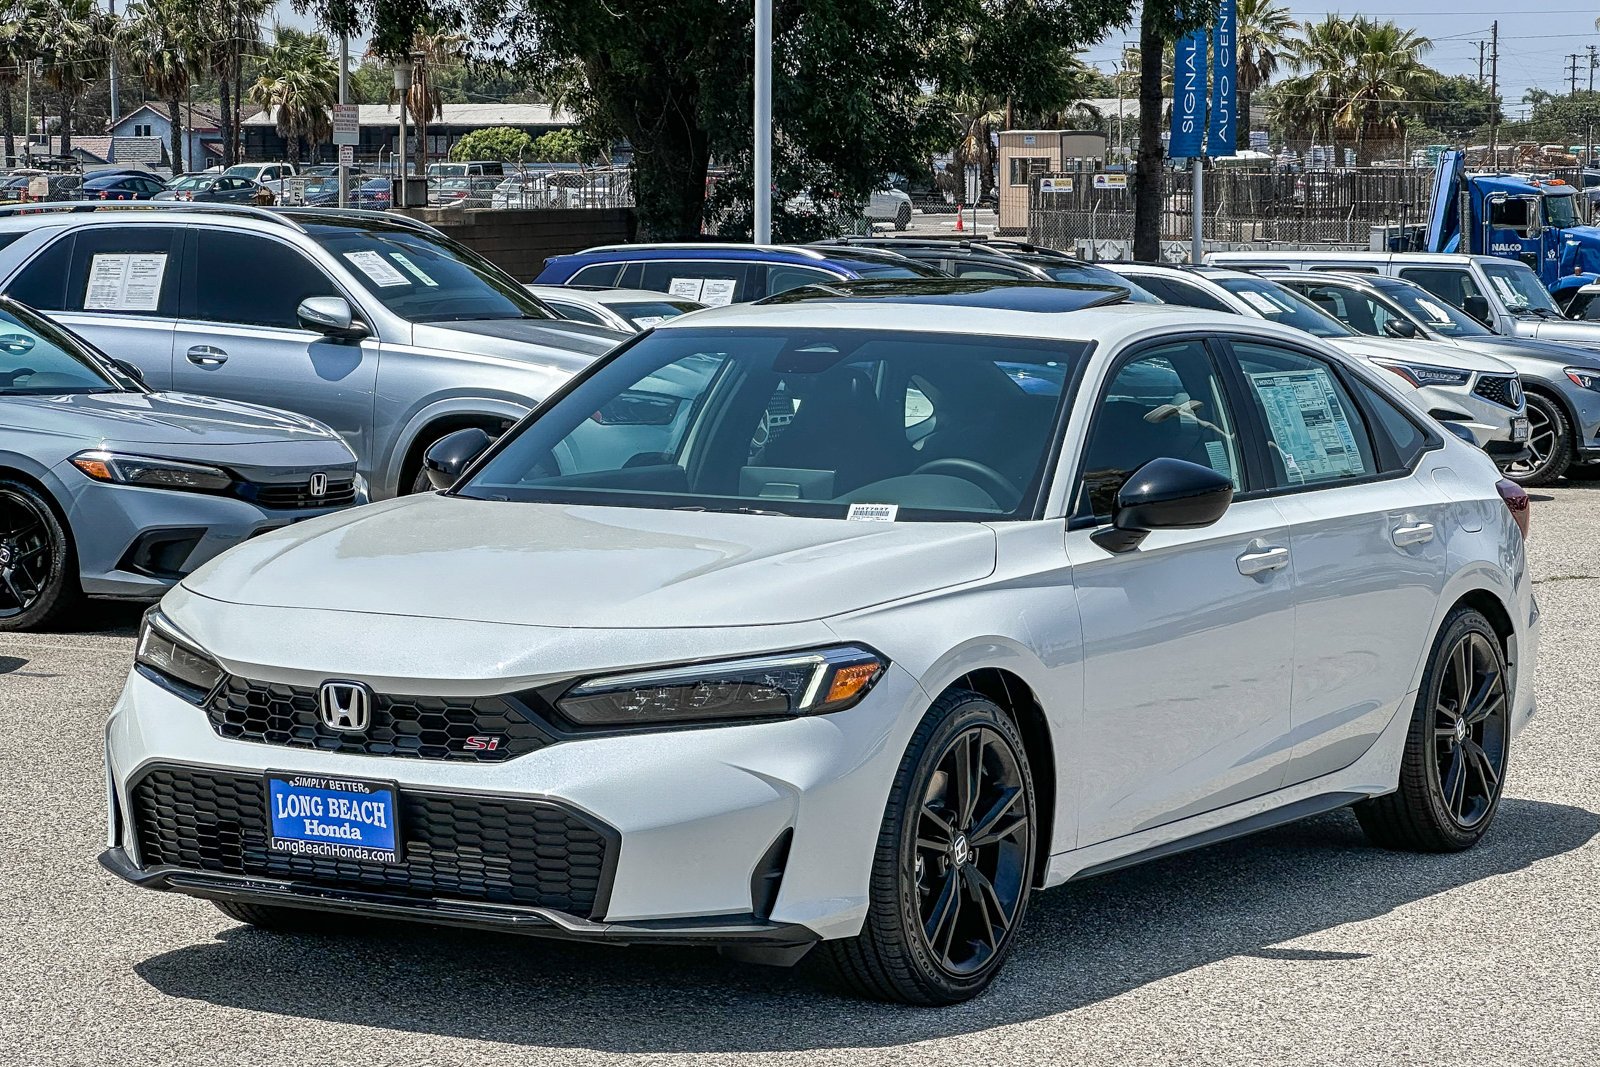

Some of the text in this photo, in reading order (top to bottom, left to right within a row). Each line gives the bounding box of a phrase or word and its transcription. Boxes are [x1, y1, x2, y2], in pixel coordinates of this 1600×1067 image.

[1218, 0, 1229, 143] AUTO CENT
[1181, 39, 1197, 134] SIGNAL
[1491, 243, 1522, 252] NALCO
[463, 736, 500, 750] Si
[294, 776, 365, 793] SIMPLY BETTER
[276, 793, 387, 829] LONG BEACH
[303, 818, 363, 840] Honda
[271, 836, 396, 862] LongBeachHonda.com
